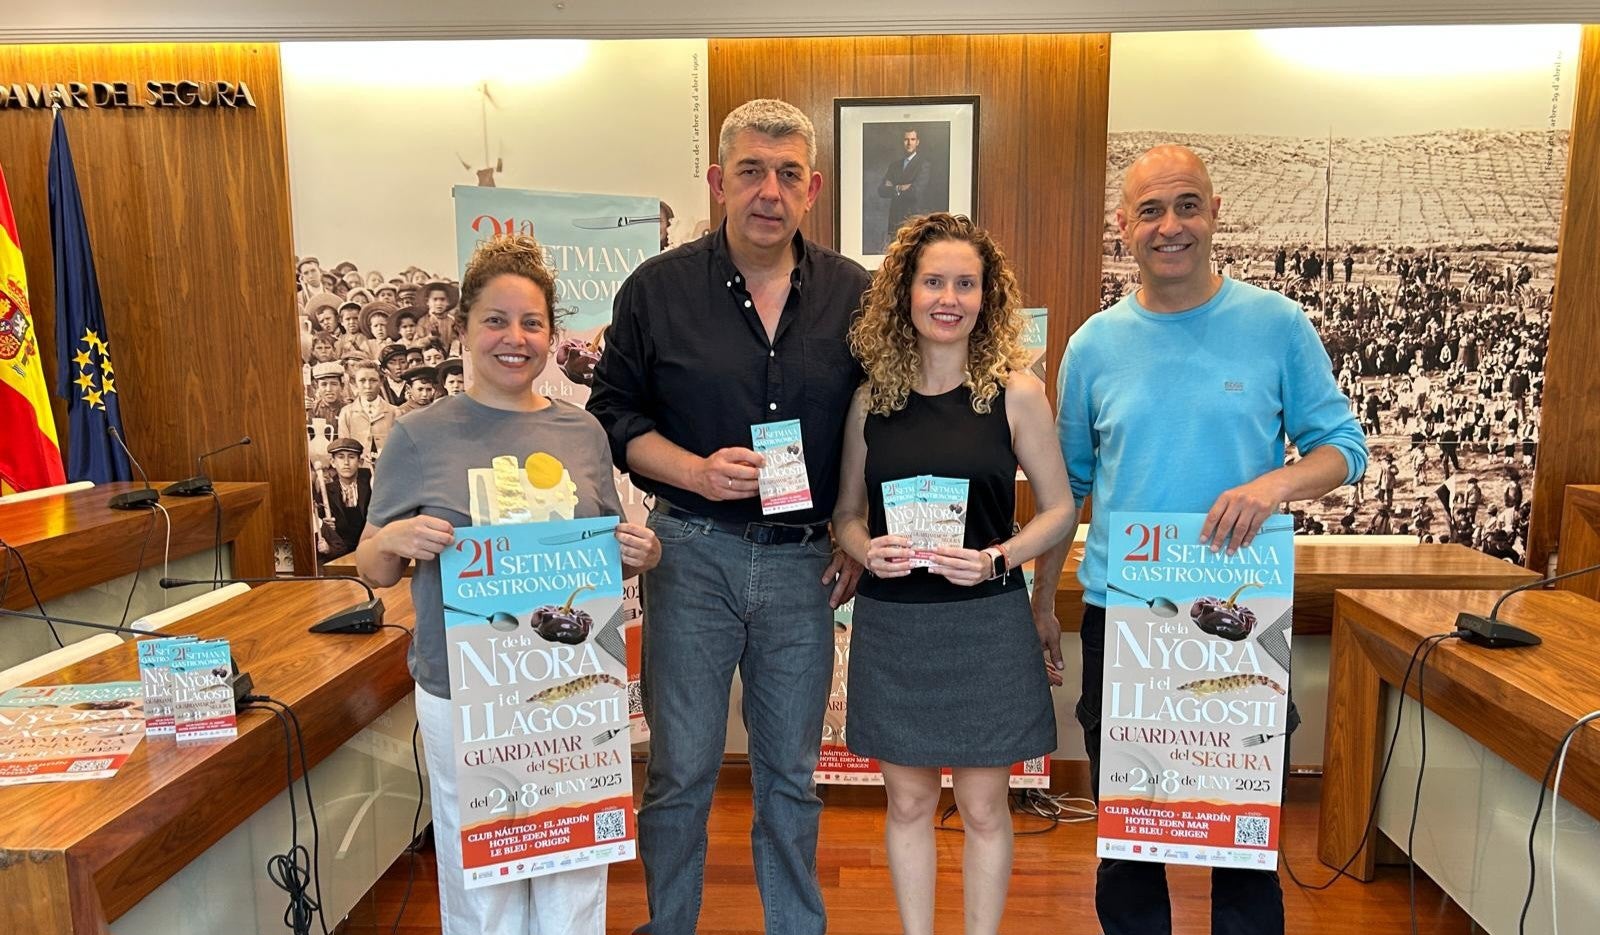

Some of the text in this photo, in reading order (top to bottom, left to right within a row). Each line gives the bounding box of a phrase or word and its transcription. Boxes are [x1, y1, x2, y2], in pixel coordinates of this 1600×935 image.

[92, 81, 144, 108] DEL
[146, 80, 256, 108] SEGURA
[692, 143, 700, 156] de
[538, 383, 573, 397] de la
[501, 548, 608, 576] SETMANA
[1167, 543, 1280, 565] SETMANA
[457, 569, 612, 600] GASTRONÒMICA
[1122, 564, 1282, 585] GASTRONÒMICA
[1160, 622, 1189, 635] de la
[502, 634, 532, 649] de la
[1112, 620, 1263, 674] NYORA
[456, 637, 604, 691] NYORA
[1157, 676, 1170, 690] el
[506, 691, 520, 705] el
[1110, 682, 1278, 728] LLAGOSTÍ
[459, 692, 621, 743] LLAGOSTÍ
[1109, 726, 1231, 748] GUARDAMAR
[464, 735, 583, 767] GUARDAMAR
[526, 749, 622, 775] del SEGURA
[1170, 749, 1272, 771] del SEGURA
[1110, 766, 1271, 794] del 2 al 8 de JUNY 2025
[470, 773, 622, 814] del 2 al 8 de JUNY 2025
[1105, 805, 1129, 815] CLUB
[1131, 805, 1175, 818] NÁUTICO
[1182, 811, 1194, 820] EL
[1195, 810, 1231, 822] JARDÍN
[1125, 816, 1209, 830] HOTEL EDEN MAR
[468, 814, 590, 843] CLUB NÁUTICO EL JARDÍN
[489, 826, 571, 849] HOTEL EDEN MAR
[1125, 825, 1208, 839] LE BLEU ORIGEN
[490, 835, 570, 858] LE BLEU ORIGEN
